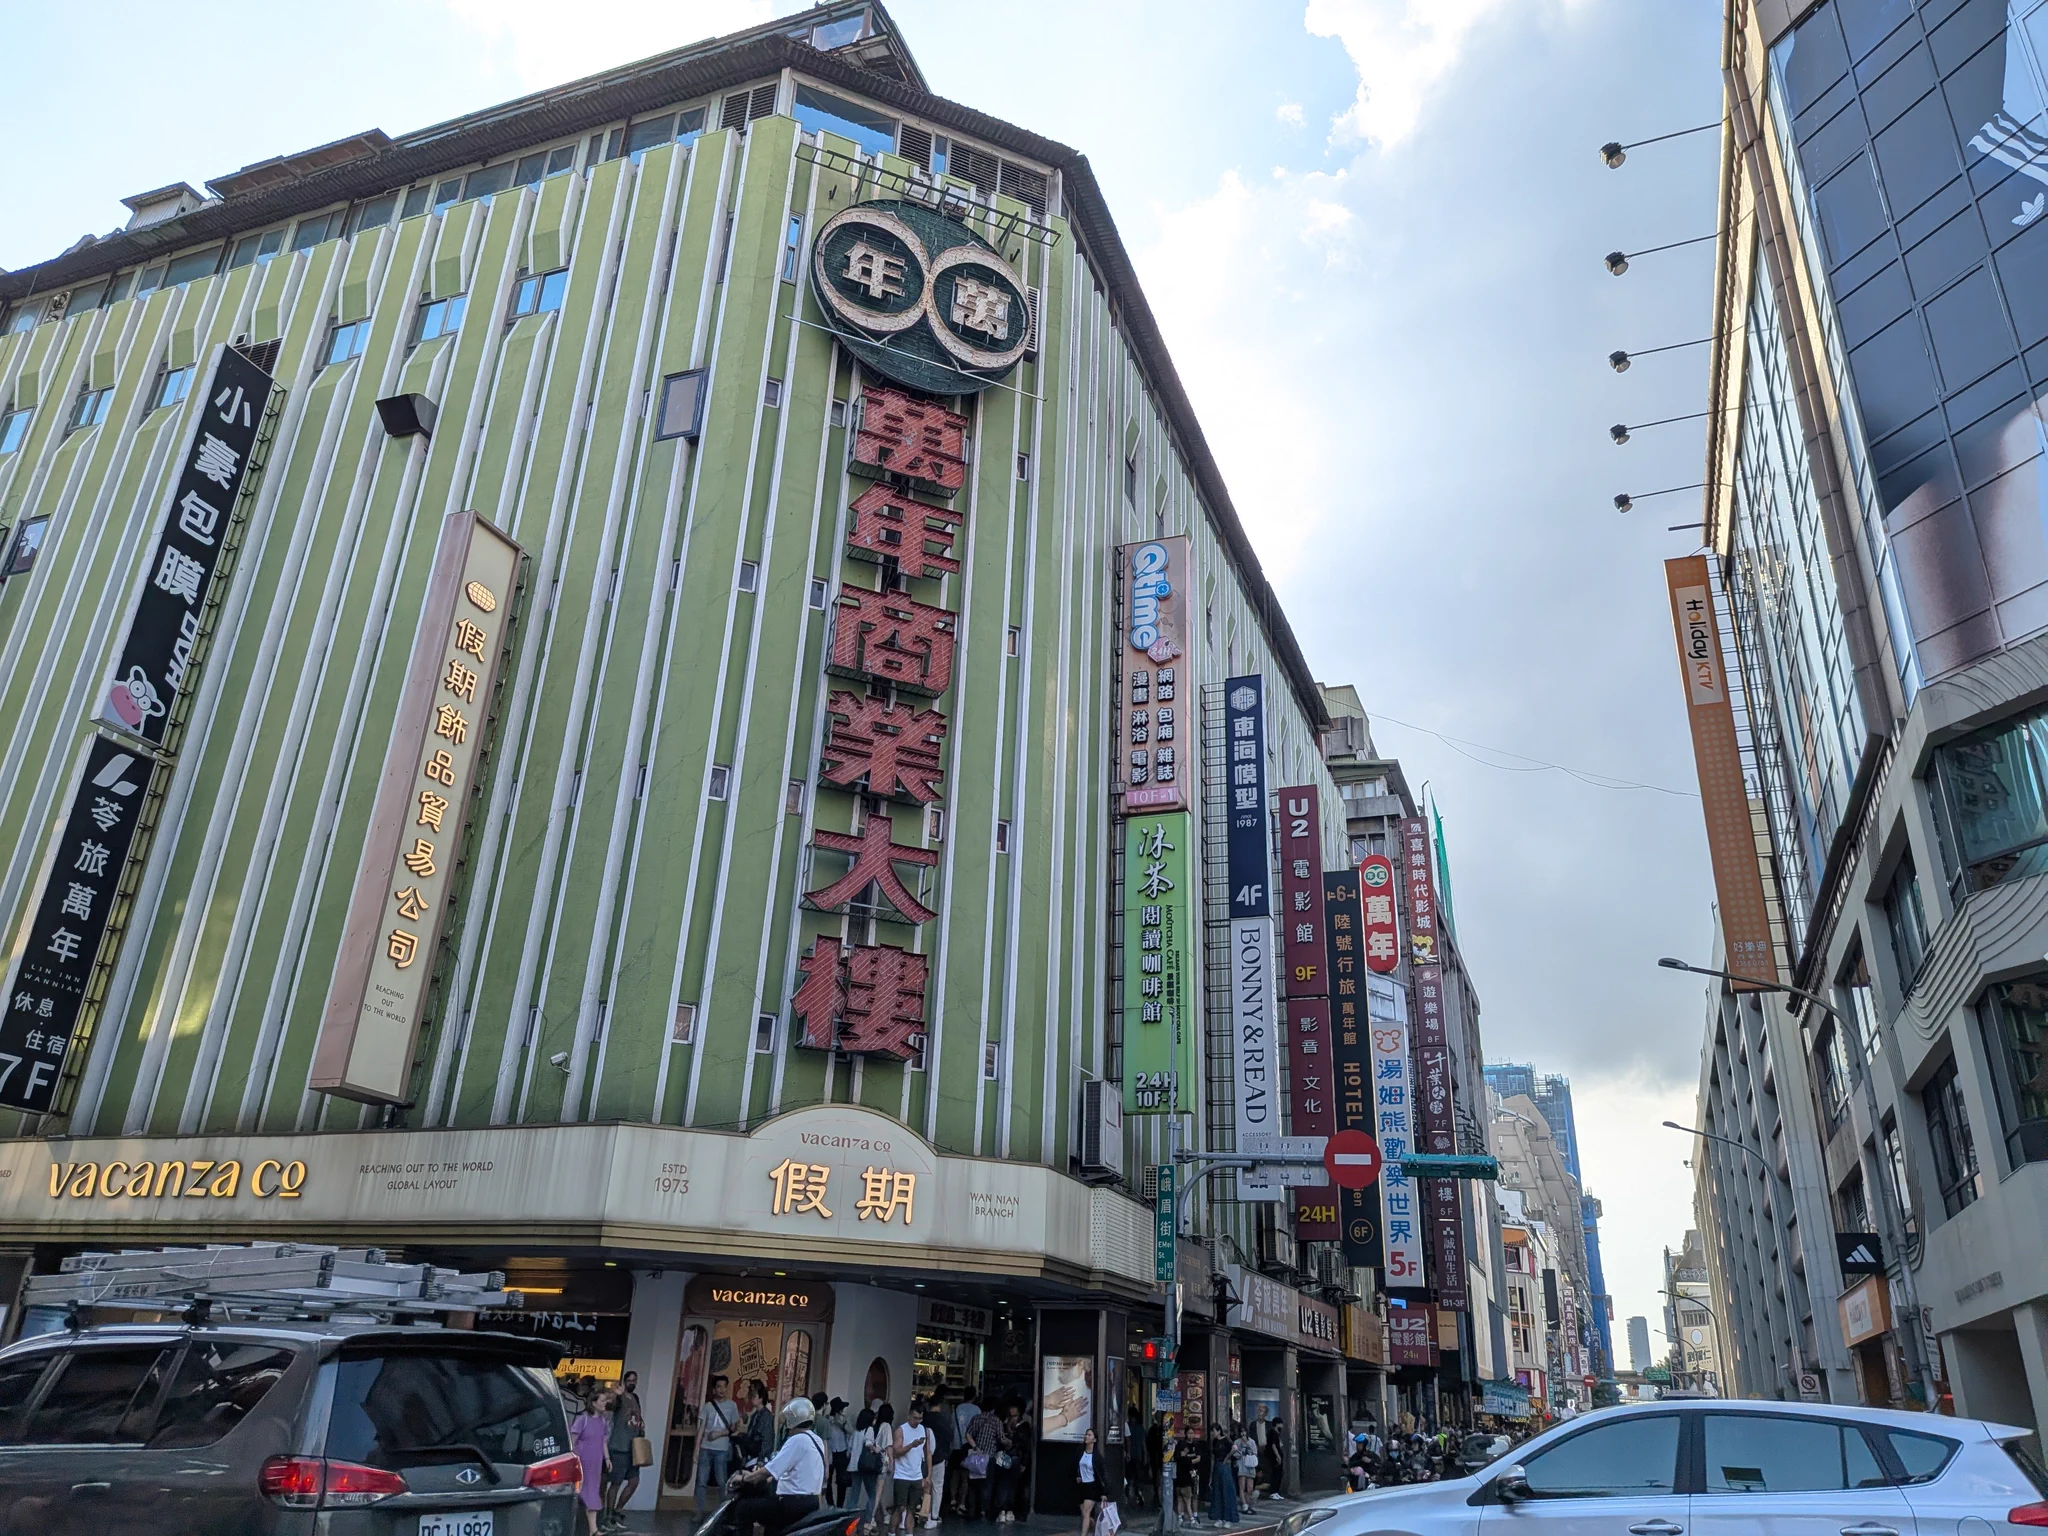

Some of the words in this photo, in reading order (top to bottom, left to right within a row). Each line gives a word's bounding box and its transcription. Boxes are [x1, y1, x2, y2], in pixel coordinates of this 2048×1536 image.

[154, 384, 253, 606] 小豪包膜
[1131, 543, 1172, 650] Qtime
[1686, 599, 1709, 659] Holiday
[1132, 671, 1149, 704] 漫畫
[1157, 668, 1174, 701] 網路
[1696, 661, 1715, 690] KTV
[791, 385, 969, 1061] 萬年商業大樓
[1132, 711, 1148, 744] 淋浴
[1157, 707, 1174, 741] 包廂
[1131, 750, 1148, 784] 電影
[1157, 747, 1174, 781] 雜誌
[387, 618, 486, 969] 假期飾品貿易公司
[1236, 818, 1258, 829] 1987
[1288, 798, 1309, 838] U2
[47, 796, 125, 963] 苓旅萬年
[1409, 837, 1432, 930] 喜樂時代影城
[1236, 884, 1263, 907] 4F
[1292, 859, 1314, 944] 電影館
[1365, 894, 1396, 962] 萬年
[1142, 904, 1163, 1024] 閱讀咖啡館
[1334, 913, 1356, 995] 陸號行旅
[23, 972, 82, 994] WANNIAN
[31, 964, 52, 975] LIN
[59, 972, 81, 983] INN
[1295, 966, 1317, 981] 9F
[14, 990, 54, 1018] 休息
[375, 984, 405, 1000] REACHING
[381, 998, 395, 1008] OUT
[363, 1003, 372, 1012] TO
[374, 1006, 384, 1017] THE
[386, 1011, 406, 1024] WORLD
[1422, 985, 1439, 1031] 遊樂場
[1341, 1001, 1357, 1046] 萬年館
[25, 1028, 66, 1056] 住宿
[0, 1053, 55, 1100] 7F
[1136, 1071, 1178, 1088] 24H
[1343, 1062, 1363, 1126] HOTEL
[800, 1131, 870, 1151] vacanza
[1376, 1058, 1413, 1244] 湯姆熊歡樂世界
[49, 1159, 243, 1199] vacanza
[359, 1163, 403, 1175] REACHING
[405, 1163, 426, 1174] OUT
[427, 1163, 440, 1173] TO
[442, 1162, 460, 1173] THE
[461, 1161, 494, 1172] WORLD
[661, 1162, 688, 1175] ESTD
[387, 1180, 421, 1192] GLOBAL
[423, 1179, 458, 1191] LAYOUT
[654, 1176, 690, 1195] 1973
[768, 1157, 917, 1226] 假期
[969, 1191, 993, 1204] WAN
[996, 1193, 1020, 1206] NIAN
[974, 1205, 1015, 1219] BRANCH
[1159, 1177, 1172, 1237] 峨眉街
[1299, 1206, 1336, 1223] 24H
[1353, 1226, 1369, 1238] 6F
[1389, 1251, 1417, 1277] 5F
[712, 1288, 786, 1306] vacanza
[1390, 1317, 1426, 1331] U2
[1390, 1331, 1427, 1347] 電影館
[556, 1361, 598, 1374] vacanza
[1403, 1350, 1419, 1360] 24H
